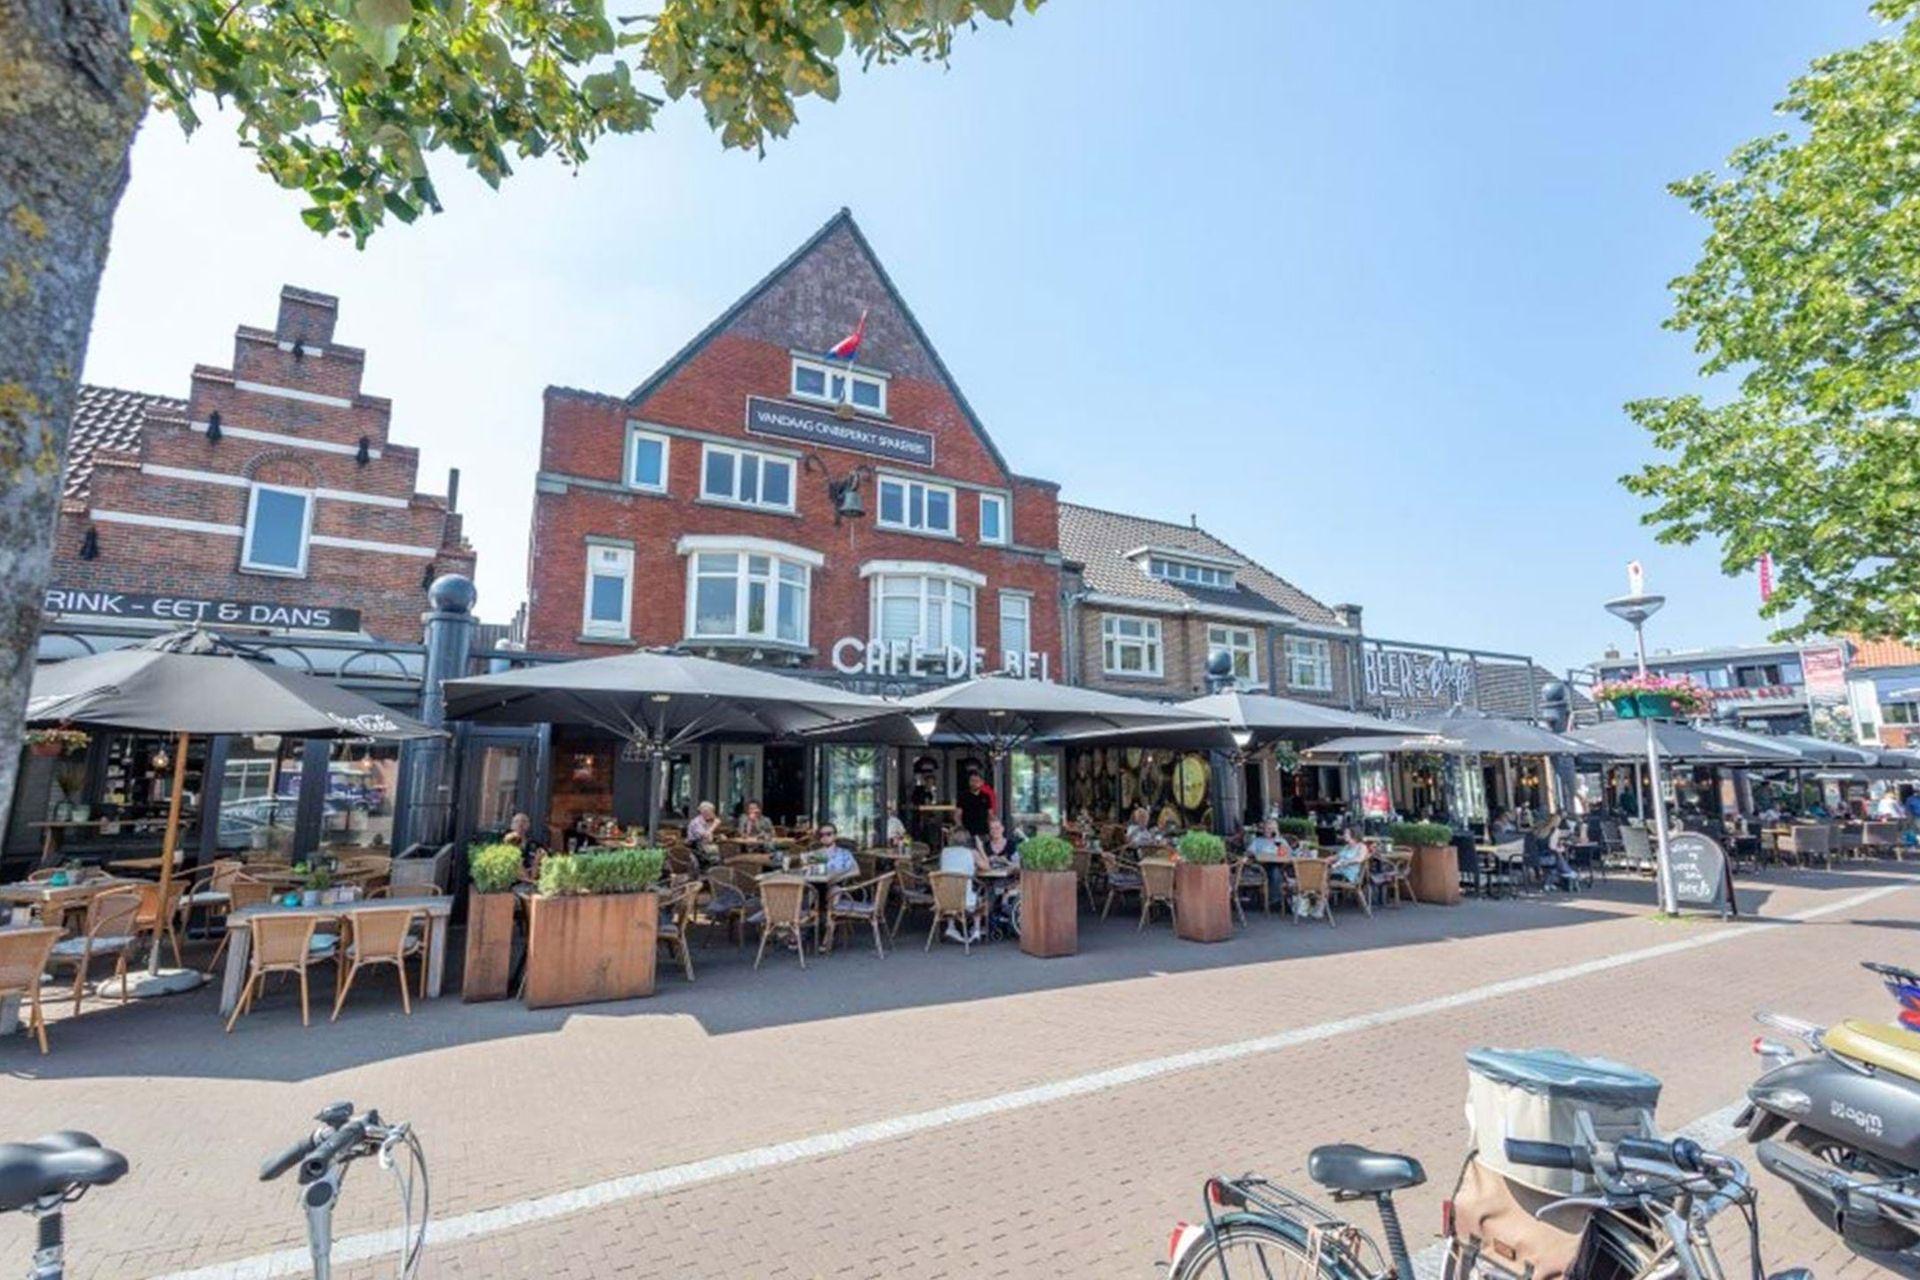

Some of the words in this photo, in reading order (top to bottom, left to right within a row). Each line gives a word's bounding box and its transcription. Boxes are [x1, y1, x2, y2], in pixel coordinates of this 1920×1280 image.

[757, 411, 814, 432] VANDAAG
[45, 590, 123, 613] RINK
[152, 599, 212, 620] EET
[218, 602, 243, 621] &
[250, 604, 331, 627] DANS
[946, 645, 986, 681] DE
[1364, 651, 1413, 698] BEER
